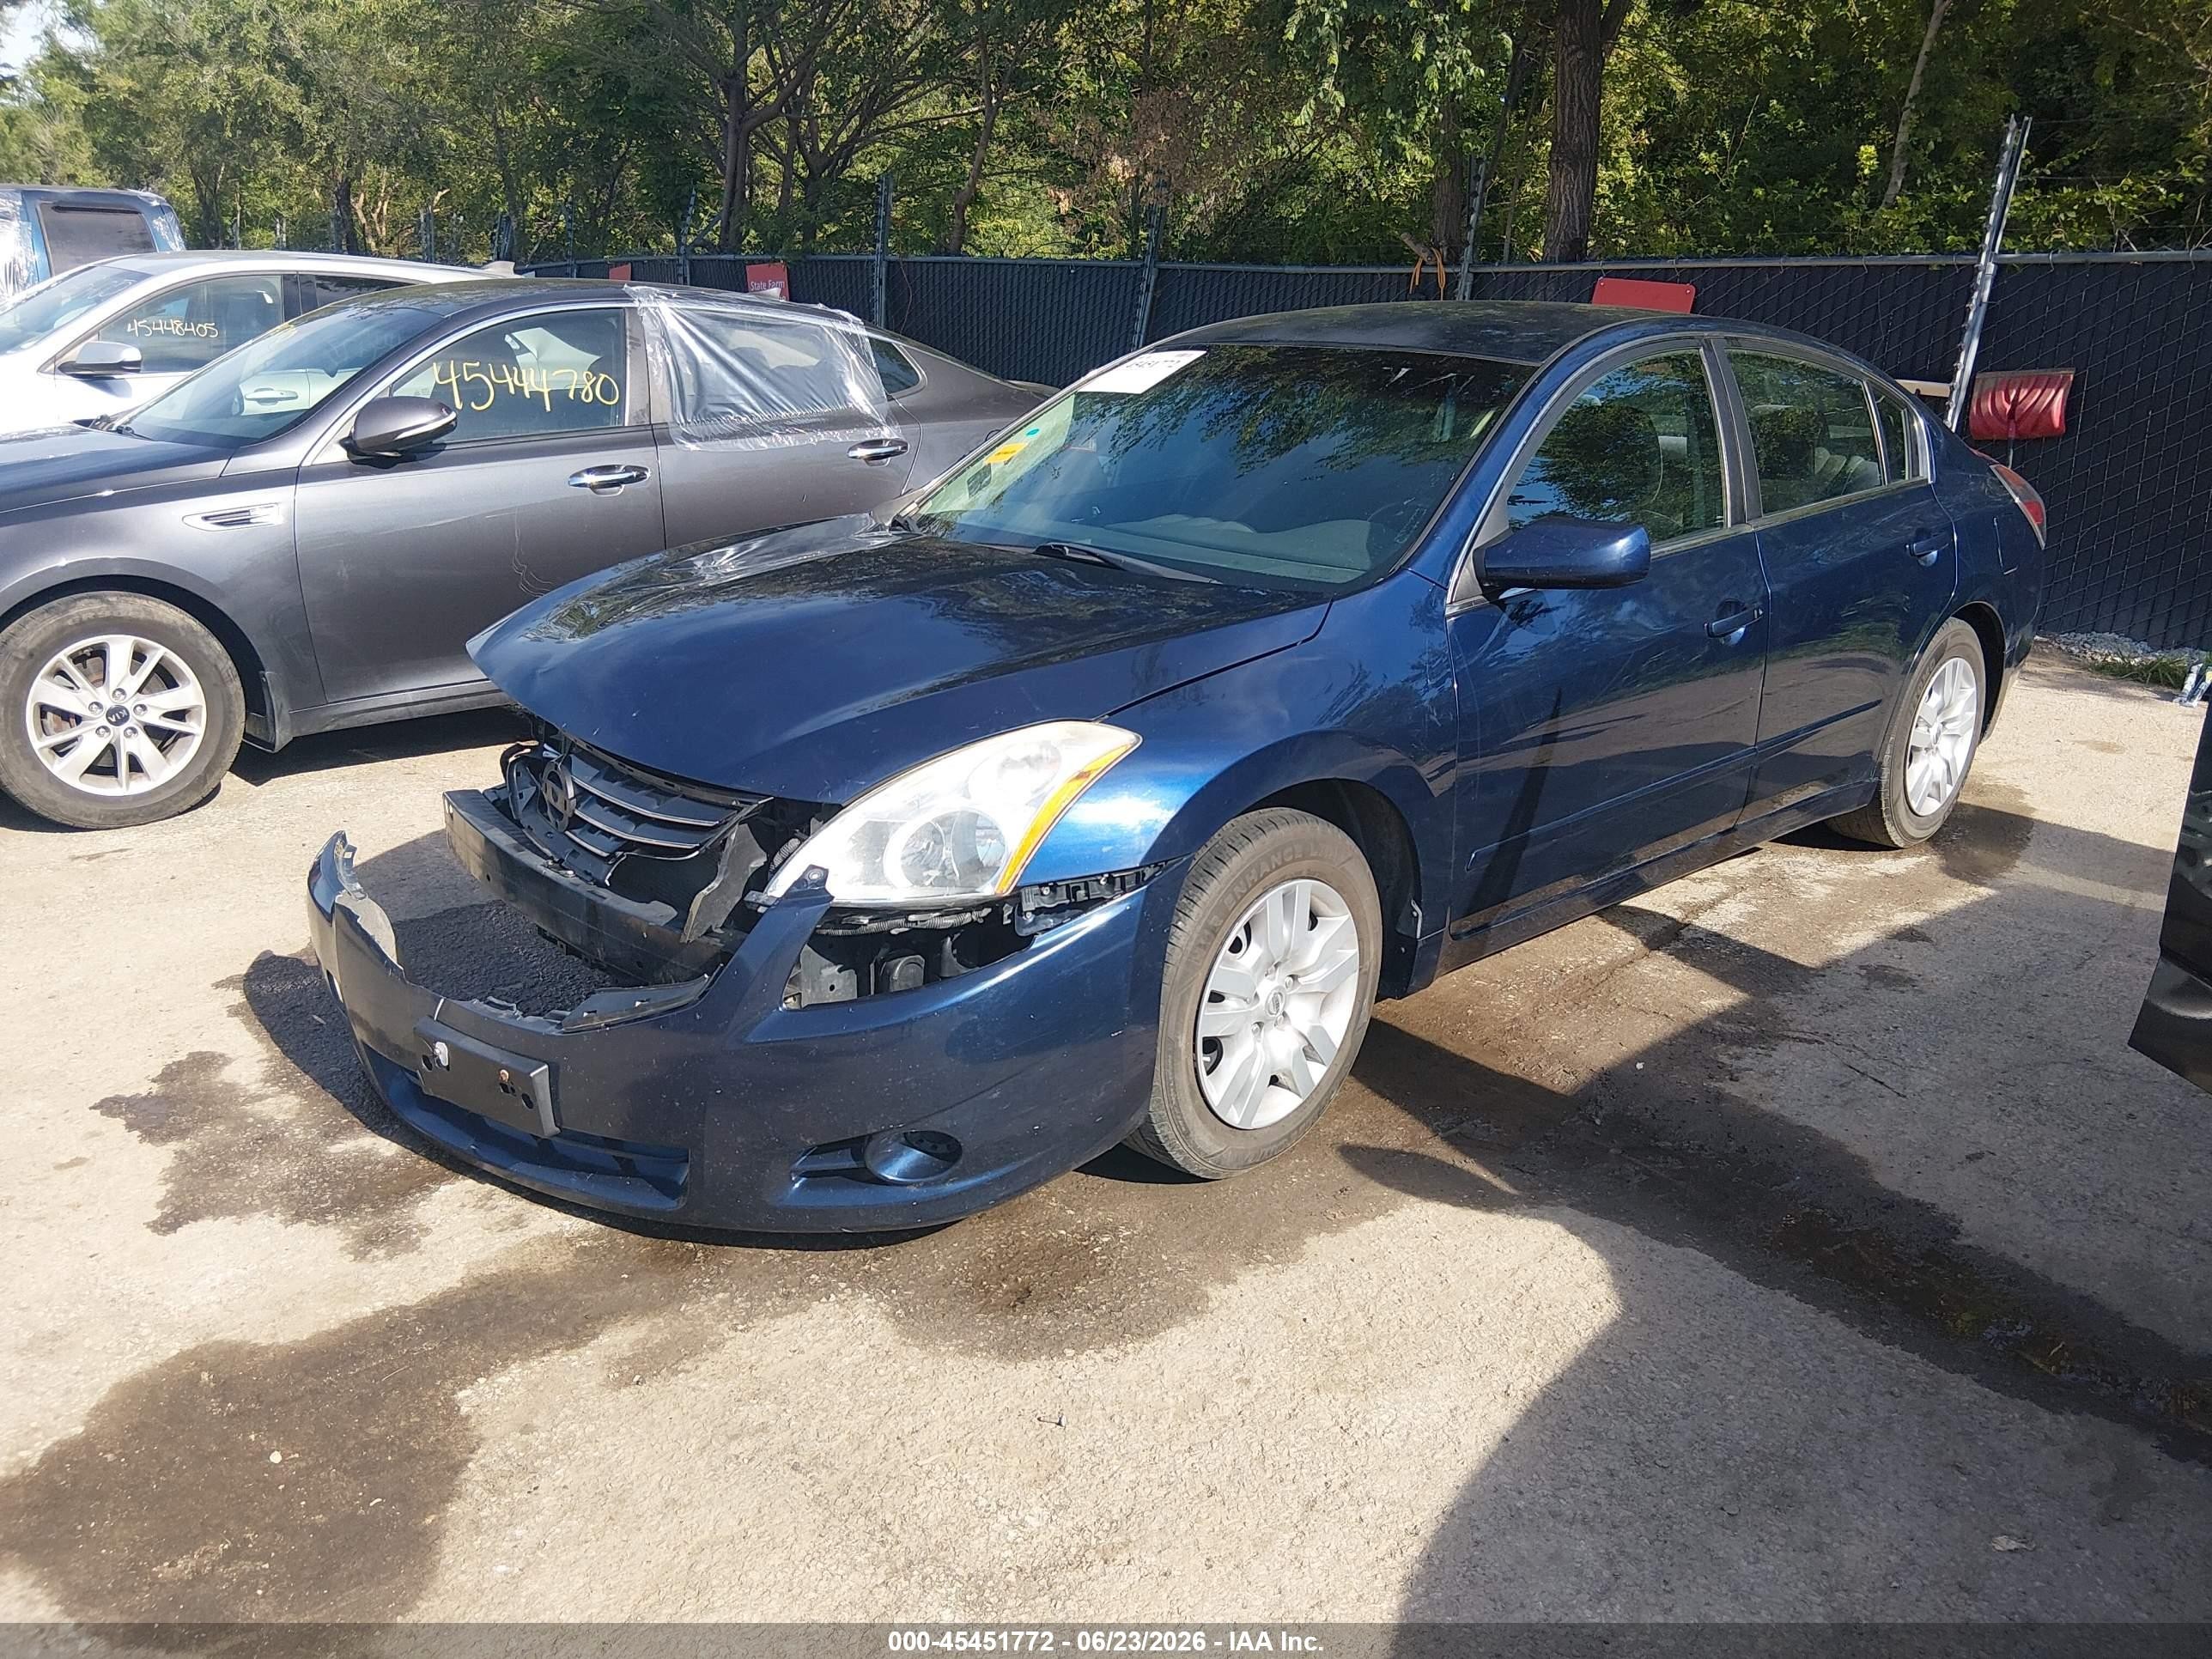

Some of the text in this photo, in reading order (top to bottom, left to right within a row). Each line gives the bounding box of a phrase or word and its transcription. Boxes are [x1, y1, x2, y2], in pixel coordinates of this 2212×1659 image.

[750, 280, 785, 291] State Farm
[127, 319, 219, 337] 45448405
[432, 359, 620, 412] 45444780
[107, 709, 128, 722] KIA
